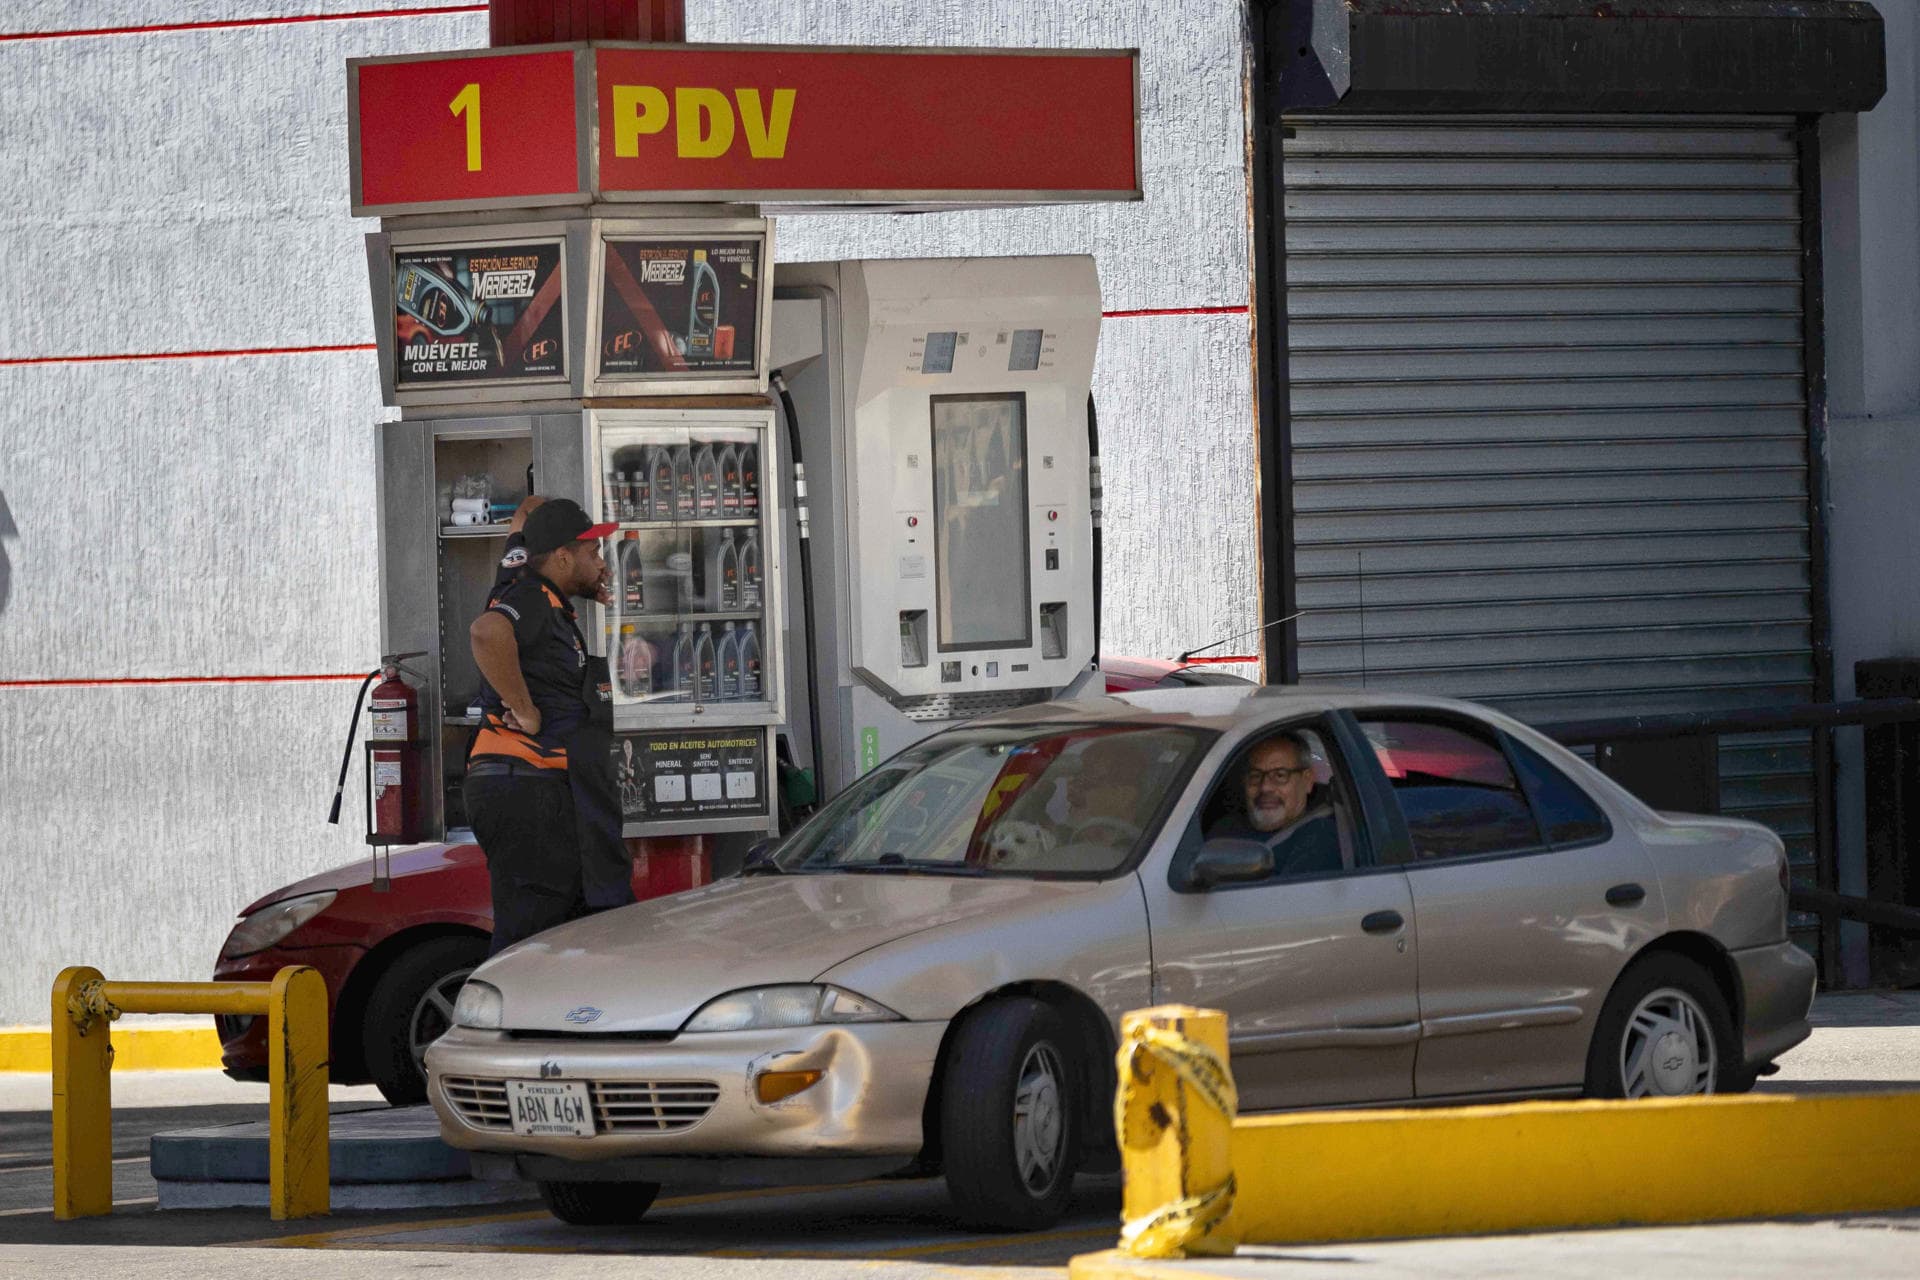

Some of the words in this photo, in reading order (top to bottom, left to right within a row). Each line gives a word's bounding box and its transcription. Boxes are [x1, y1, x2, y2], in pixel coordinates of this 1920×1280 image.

[448, 83, 481, 172] 1
[613, 84, 797, 159] PDV
[469, 255, 500, 273] ESTACIÓN
[508, 256, 539, 271] SERVICIO
[472, 270, 536, 301] MARIPEREZ
[404, 339, 479, 361] MUÉVETE
[532, 340, 548, 361] FC
[614, 332, 633, 353] FC
[412, 362, 434, 374] CON
[436, 361, 448, 372] EL
[451, 359, 487, 372] MEJOR
[650, 742, 669, 751] TODO
[669, 742, 679, 750] EN
[680, 740, 706, 750] ACEITES
[707, 738, 757, 749] AUTOMOTRICES
[655, 760, 682, 768] MINERAL
[528, 1087, 564, 1095] VENEZUELA
[517, 1096, 549, 1122] ABN
[554, 1096, 586, 1123] 46W
